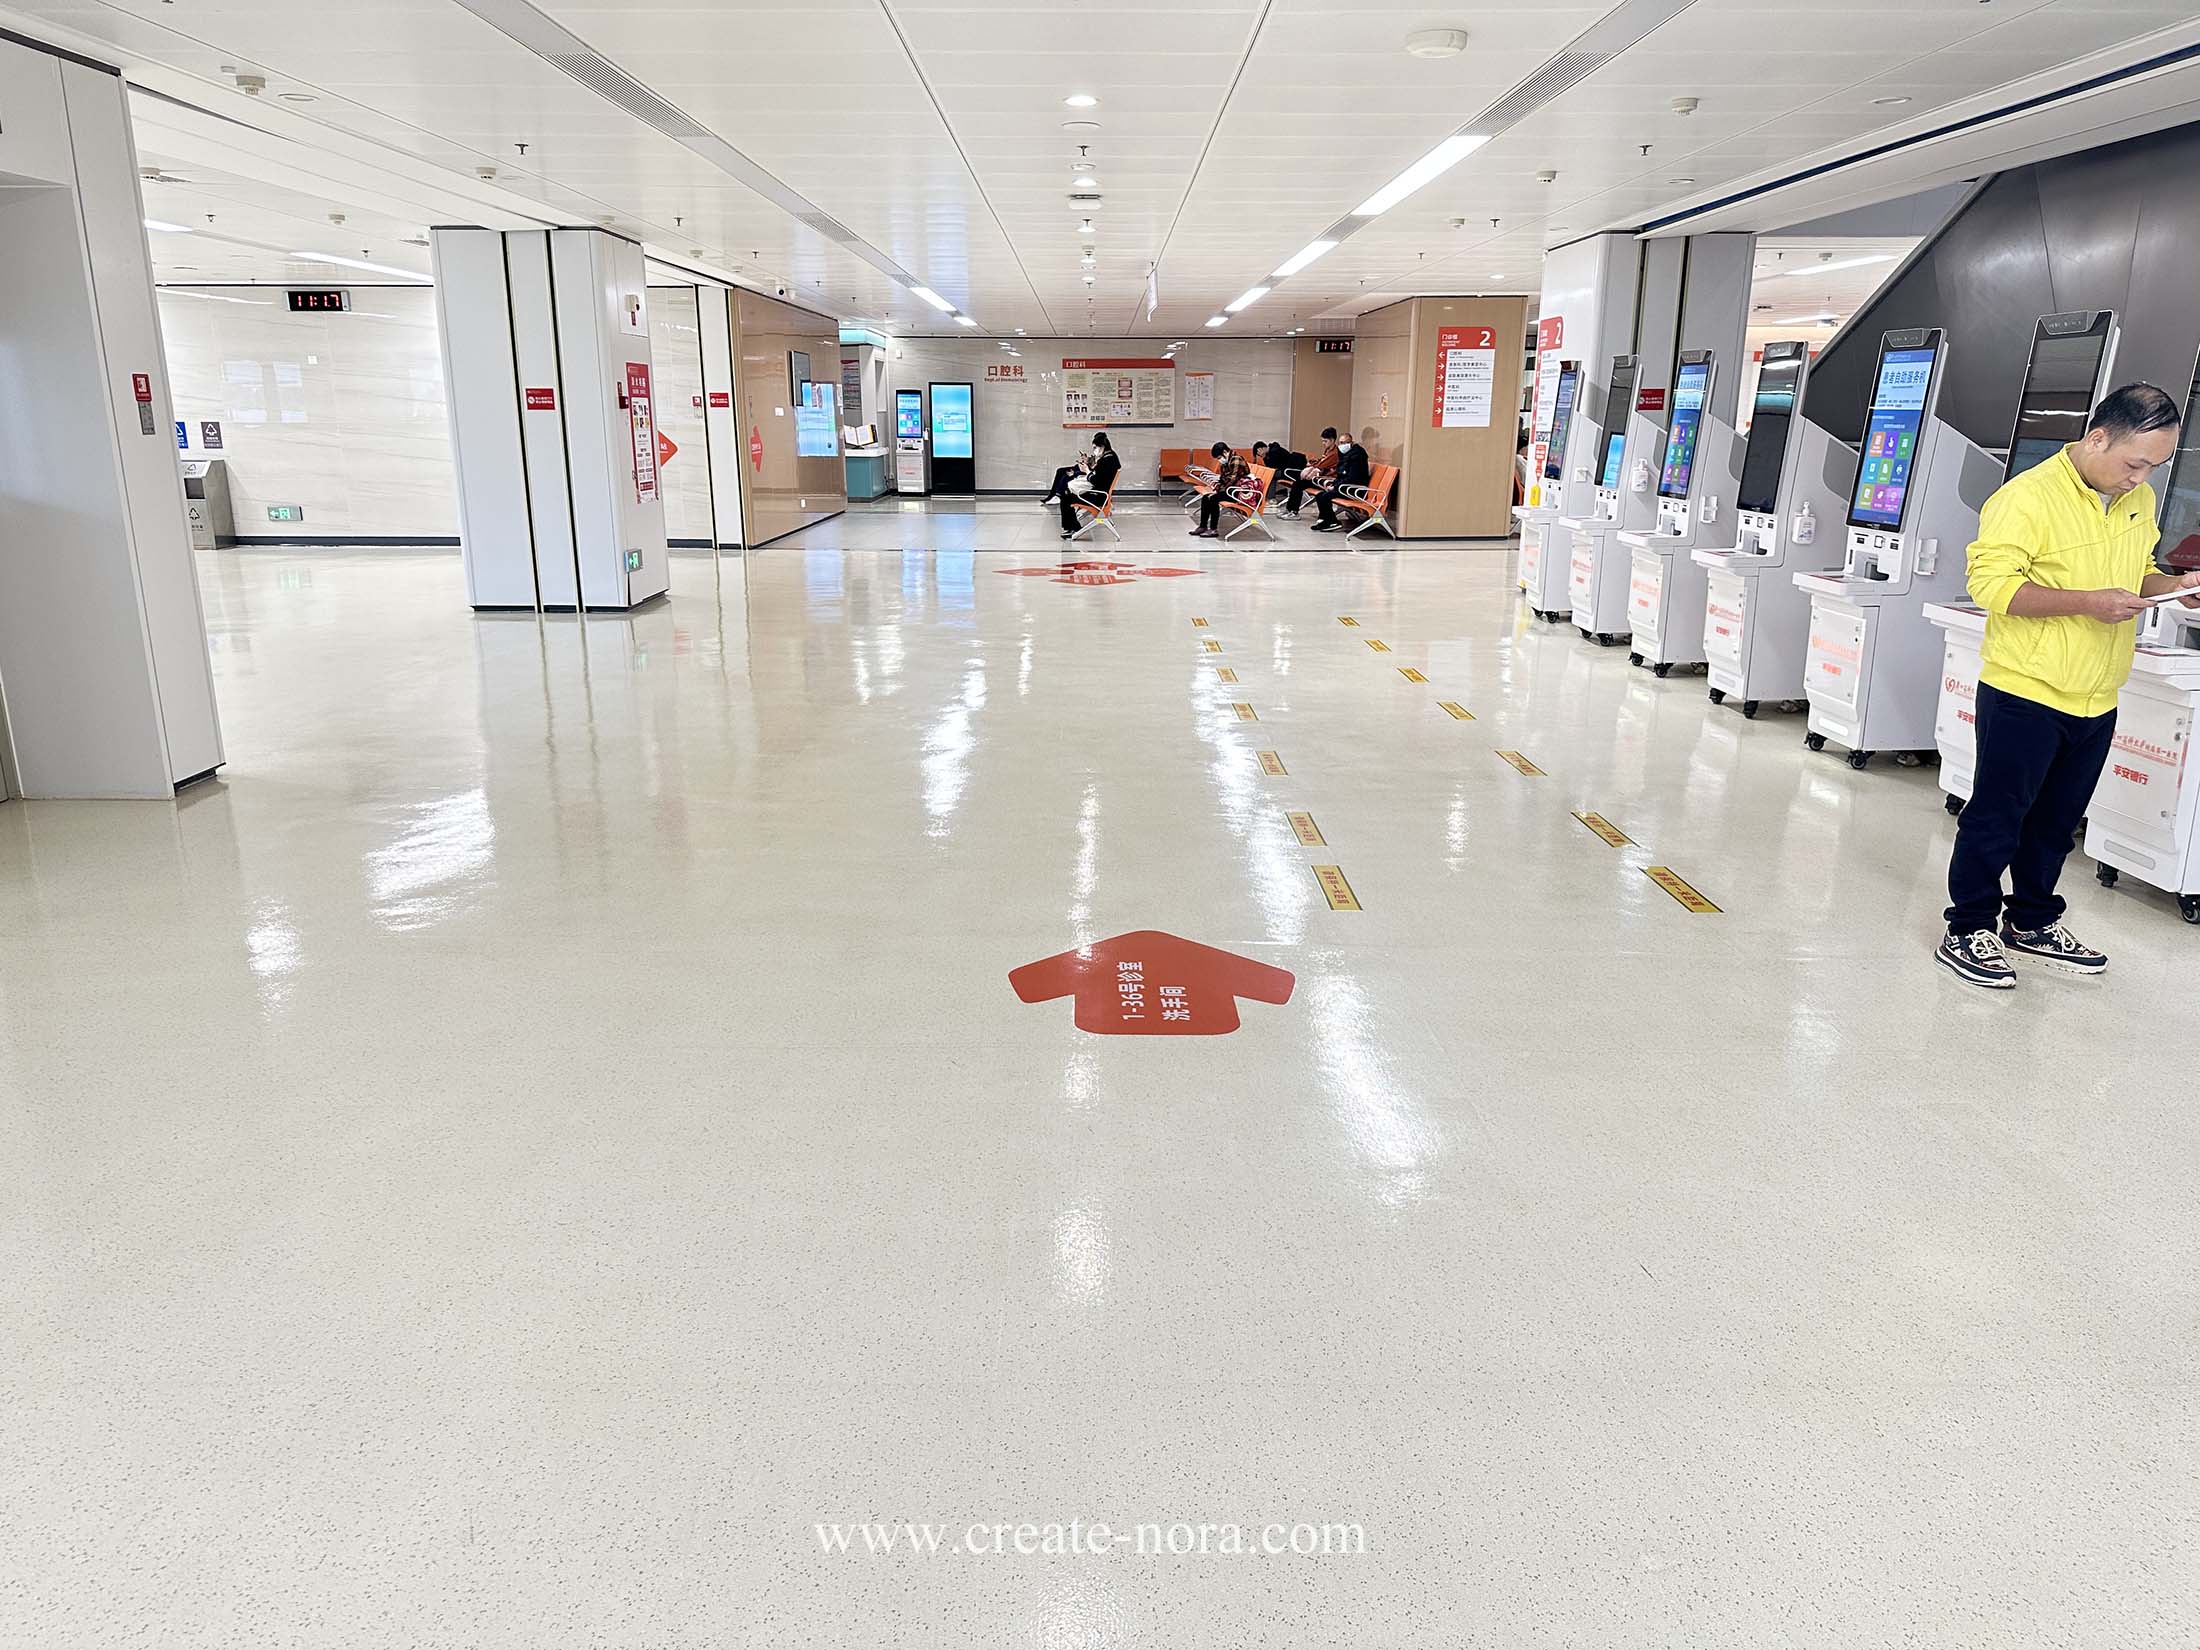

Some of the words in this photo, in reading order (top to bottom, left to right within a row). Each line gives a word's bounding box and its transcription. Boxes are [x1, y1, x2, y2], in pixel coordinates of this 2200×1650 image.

[1479, 331, 1491, 347] 2
[1555, 322, 1562, 345] 2
[1324, 341, 1351, 350] 11:17
[987, 365, 1025, 377] 口腔科
[2112, 764, 2149, 785] 平安银行
[1117, 961, 1145, 1020] 1-36号诊室
[1160, 986, 1190, 1021] 洗手间
